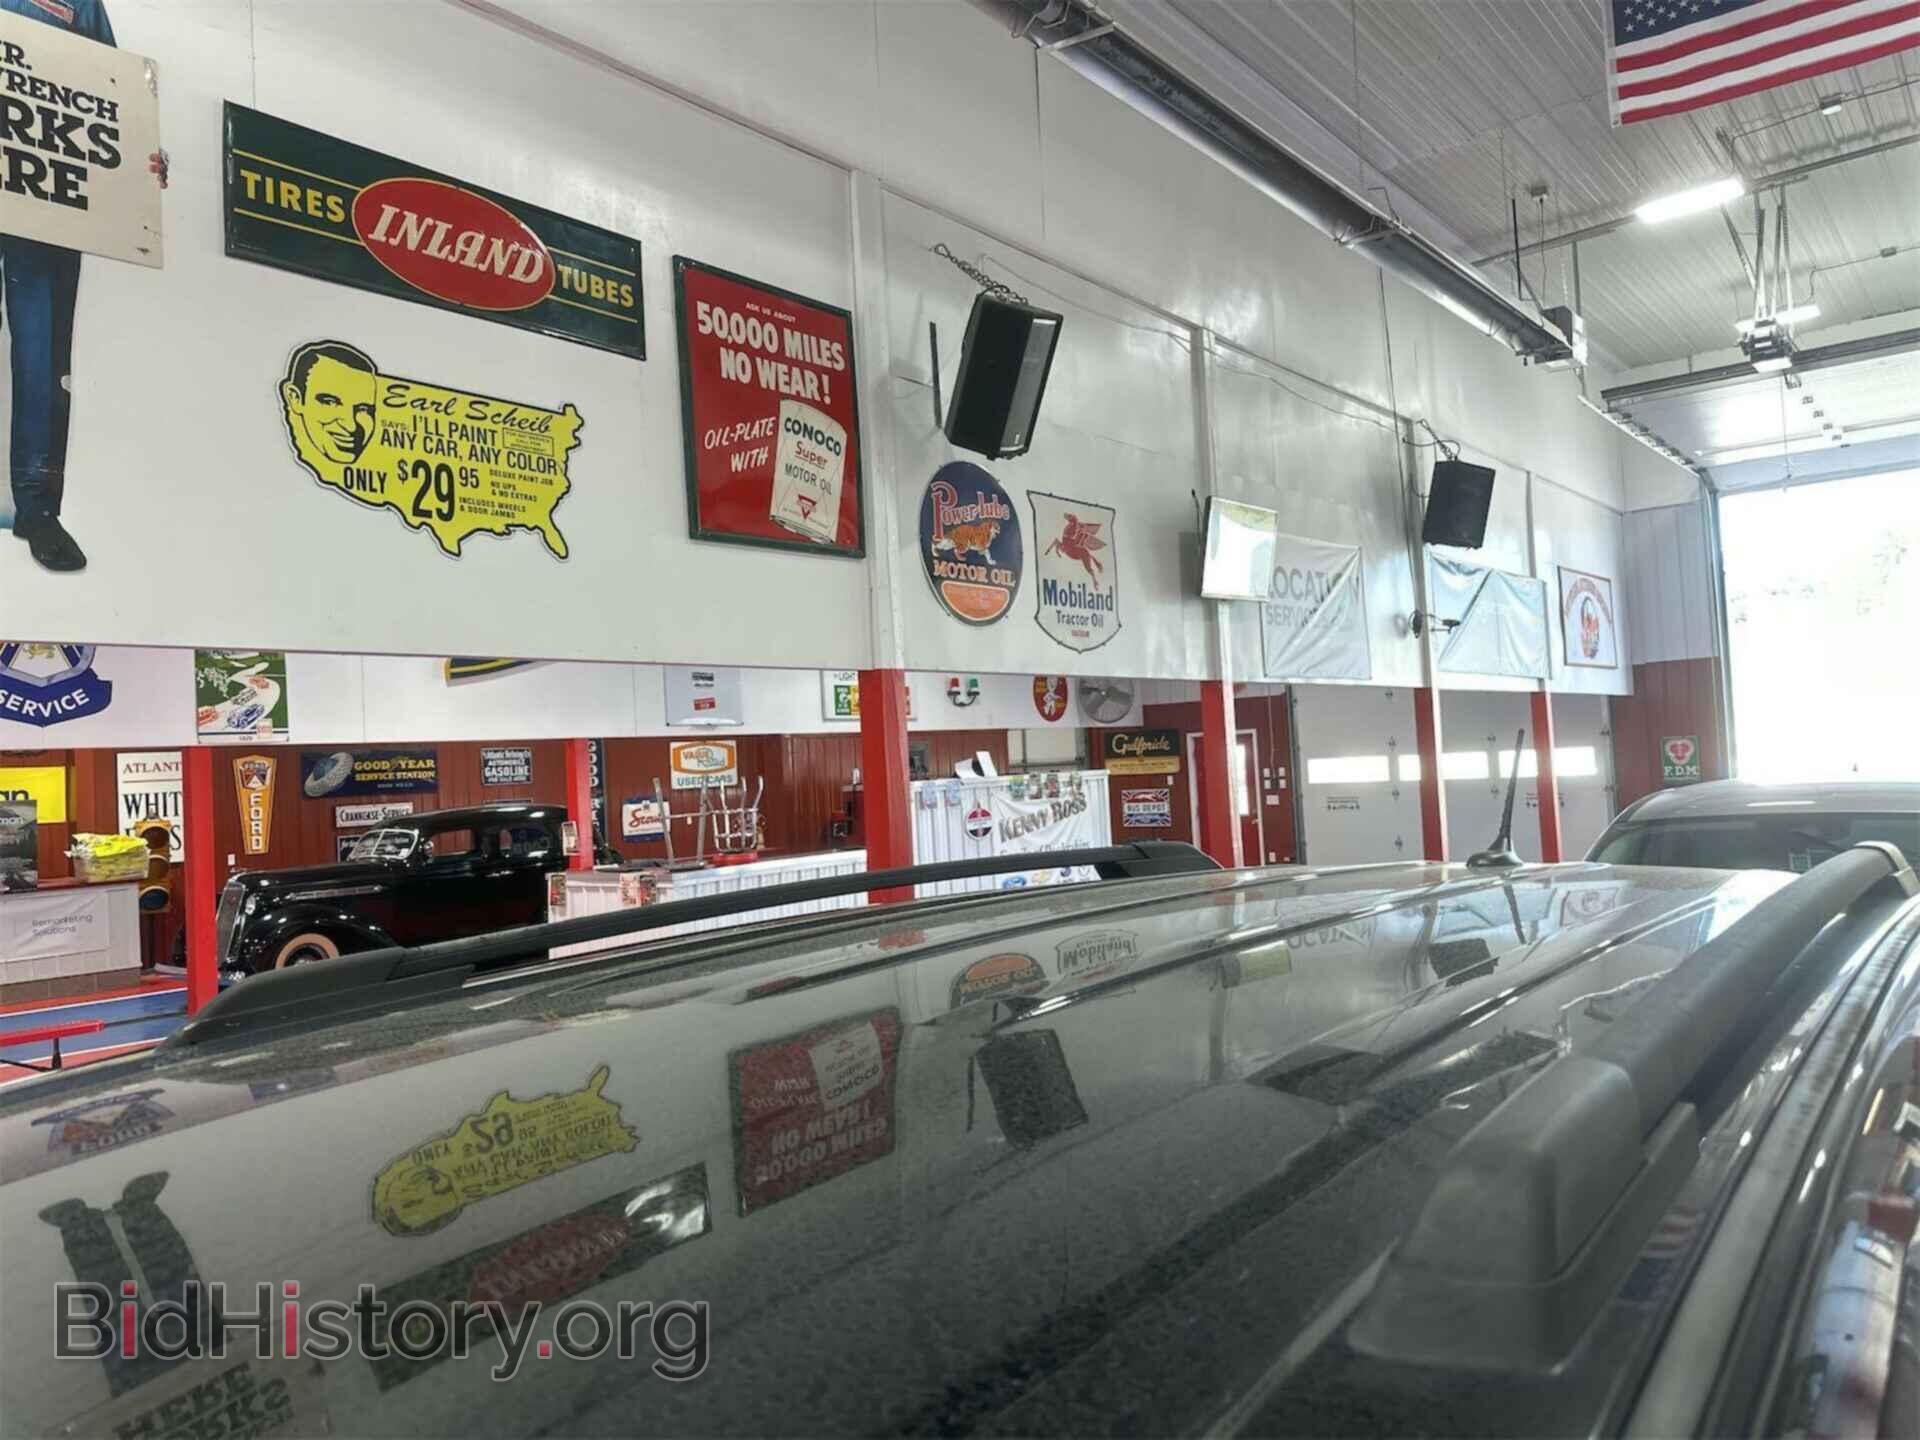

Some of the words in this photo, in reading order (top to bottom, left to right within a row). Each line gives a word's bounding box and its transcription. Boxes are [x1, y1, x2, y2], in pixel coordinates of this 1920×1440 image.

[0, 40, 32, 70] R.
[0, 67, 119, 122] RENCH
[240, 168, 345, 224] TIRES
[367, 203, 544, 285] INLAND
[558, 263, 633, 308] TUBES
[719, 346, 752, 385] NO
[783, 327, 845, 372] MILES
[382, 383, 456, 416] Earl
[413, 415, 441, 436] I'LL
[449, 422, 498, 446] PAINT
[465, 401, 552, 434] Scheib
[704, 416, 777, 450] OIL-PLATE
[380, 429, 416, 451] ANY
[423, 436, 463, 462] CAR,
[468, 445, 500, 466] ANY
[506, 451, 558, 476] COLOR
[784, 416, 842, 457] CONOCO
[731, 446, 769, 473] WITH
[795, 440, 828, 470] Super
[343, 466, 388, 494] ONLY
[459, 466, 480, 489] 95
[784, 463, 817, 487] MOTOR
[819, 477, 832, 496] OIL
[933, 559, 988, 583] MOTOR
[991, 568, 1016, 587] OIL
[1043, 578, 1114, 612] Mobiland
[1056, 610, 1090, 626] Tractor
[1090, 613, 1104, 628] Oil
[485, 765, 529, 777] GASOLINE
[999, 809, 1048, 843] KENNY
[1051, 793, 1087, 823] ROSS
